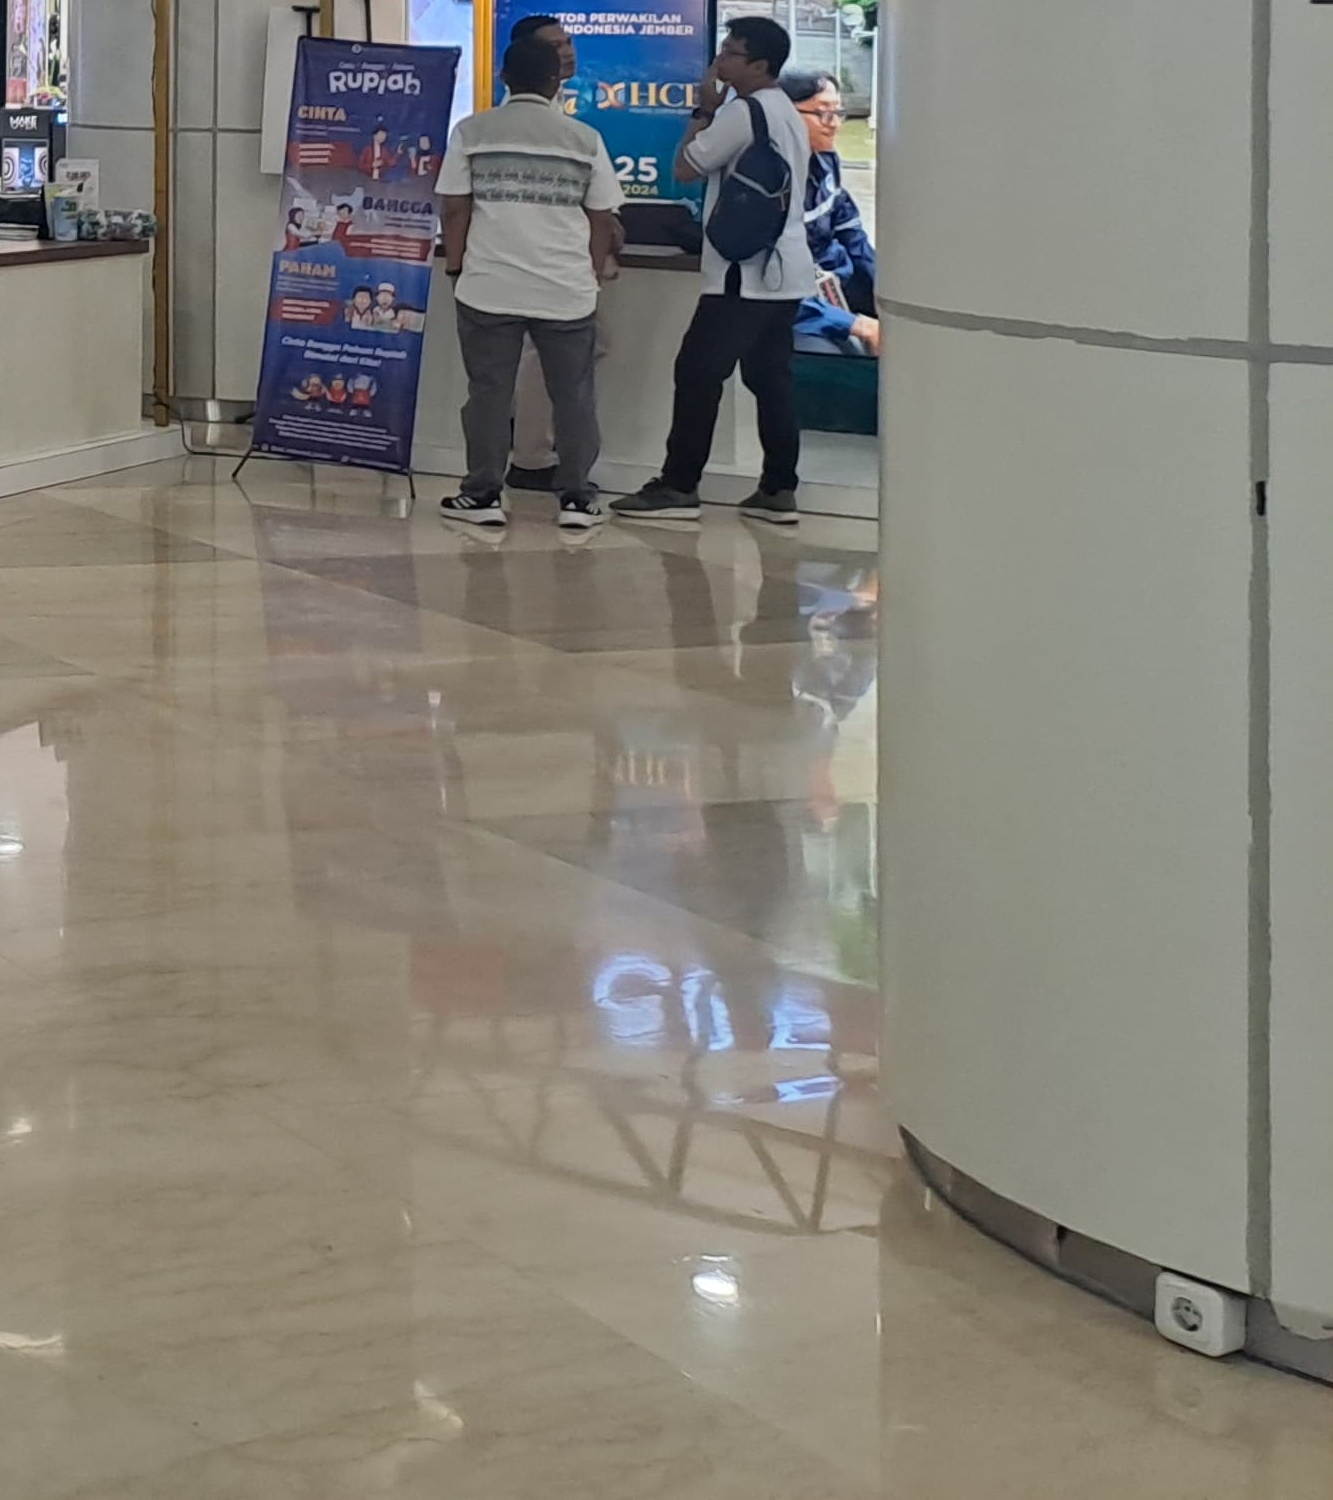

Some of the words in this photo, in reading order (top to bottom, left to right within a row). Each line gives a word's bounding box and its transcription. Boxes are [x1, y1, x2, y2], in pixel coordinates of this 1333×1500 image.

[589, 12, 682, 24] PERWAKILAN
[561, 24, 636, 36] NDONESIA
[638, 24, 695, 36] JEMBER
